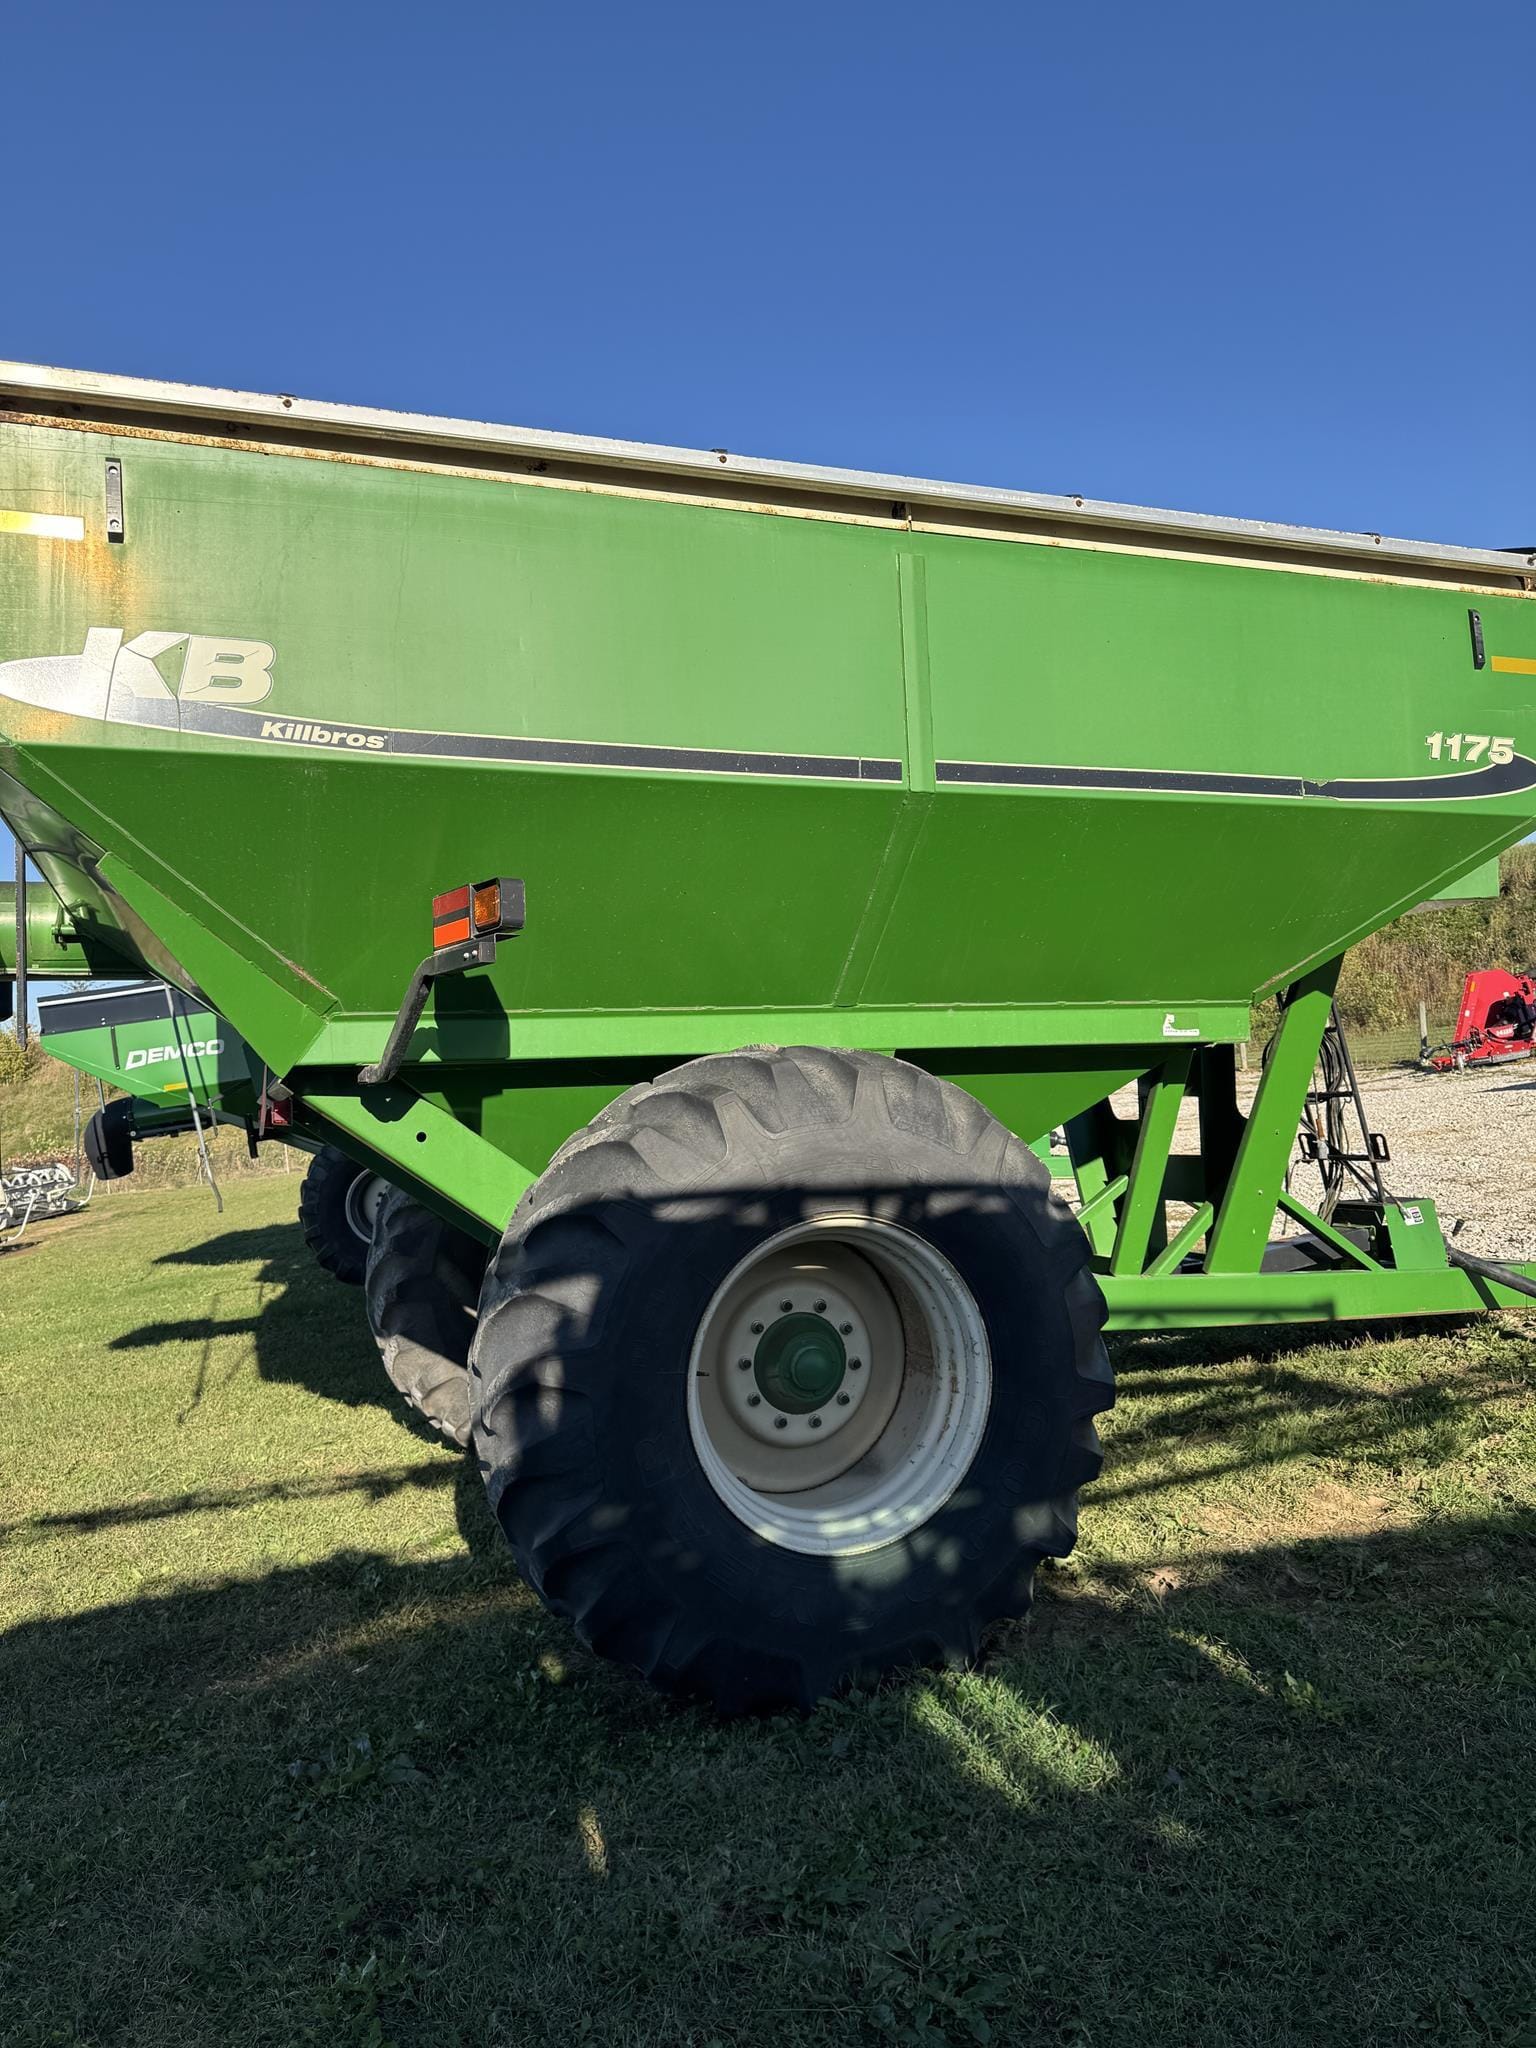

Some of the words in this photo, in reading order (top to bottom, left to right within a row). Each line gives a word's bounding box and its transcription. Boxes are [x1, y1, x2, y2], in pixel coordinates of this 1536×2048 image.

[84, 627, 276, 710] KB
[261, 721, 387, 748] Killbros
[1425, 731, 1515, 764] 1175
[125, 1039, 225, 1070] DEMCO
